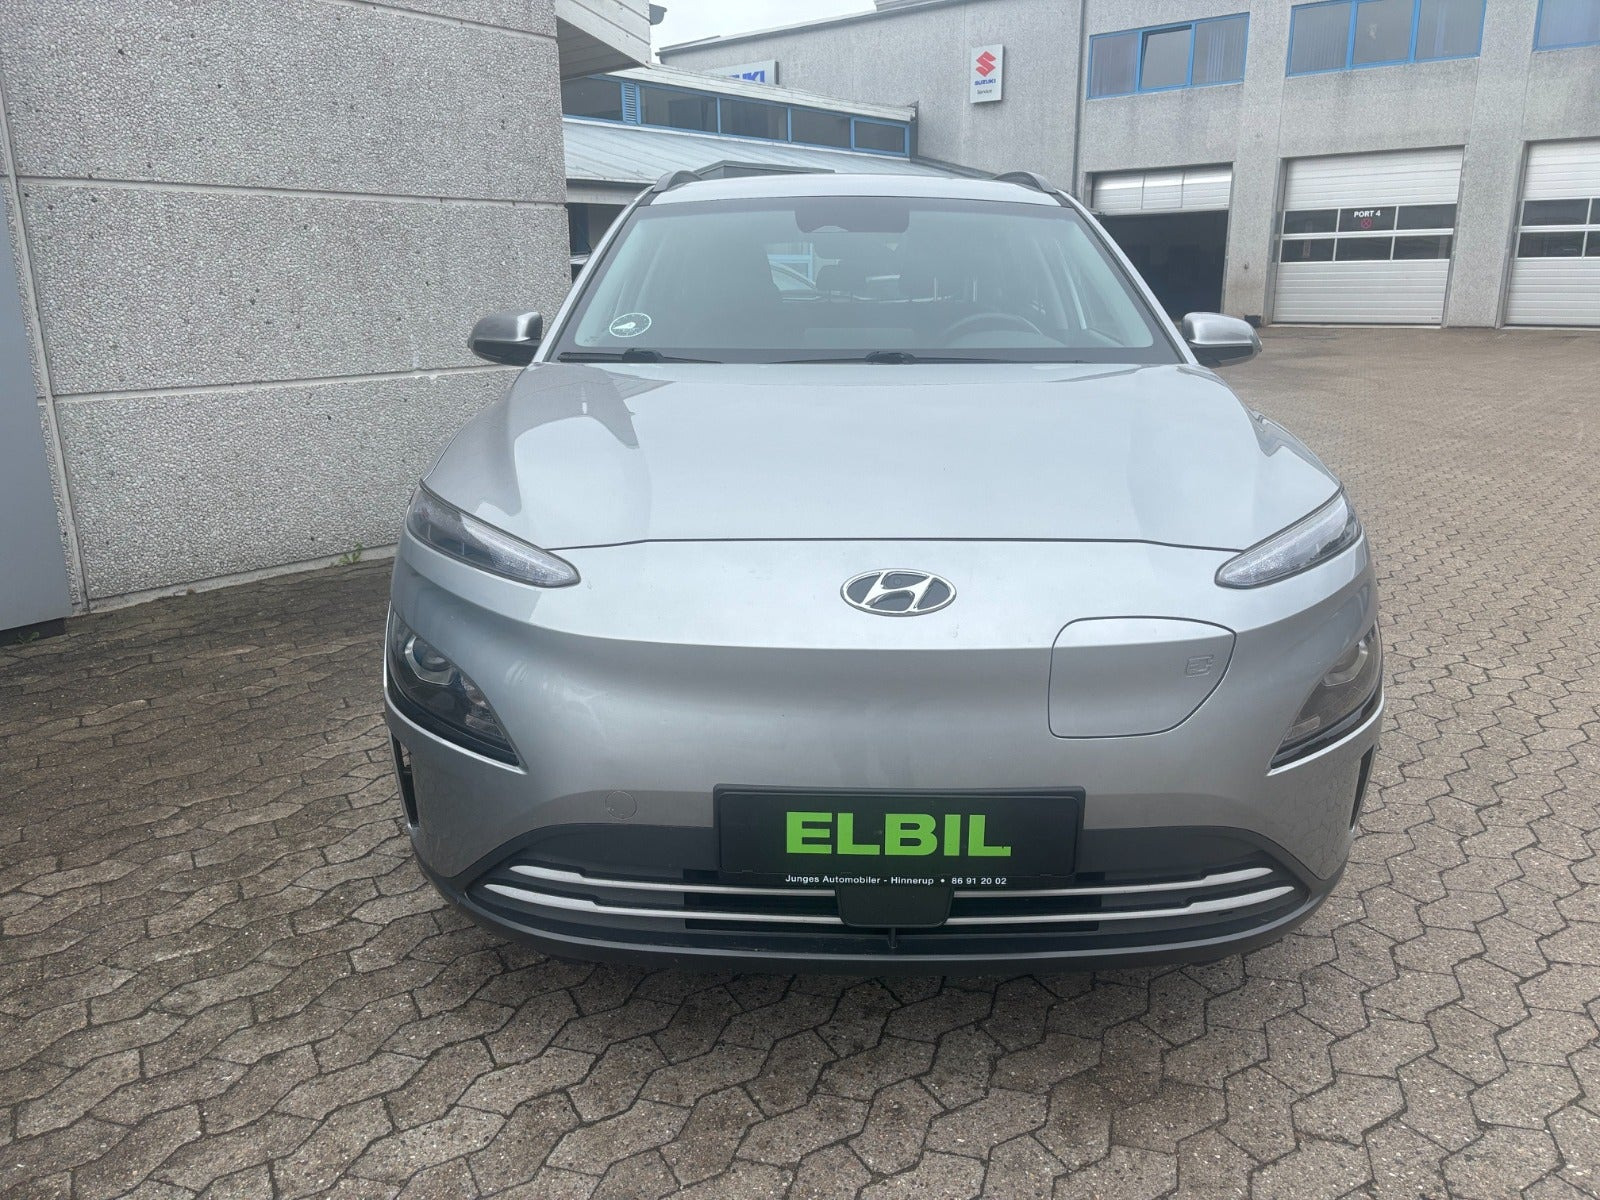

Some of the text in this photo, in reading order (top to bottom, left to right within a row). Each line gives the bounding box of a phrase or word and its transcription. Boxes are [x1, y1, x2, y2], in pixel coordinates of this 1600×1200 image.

[1353, 210, 1375, 218] PORT
[786, 811, 1012, 857] ELBIL
[785, 874, 820, 884] Junges
[822, 875, 881, 884] Automobiler
[890, 876, 935, 886] Hinnerup
[951, 877, 963, 885] 86
[966, 877, 977, 885] 91
[980, 877, 992, 885] 20
[995, 877, 1007, 885] 02
